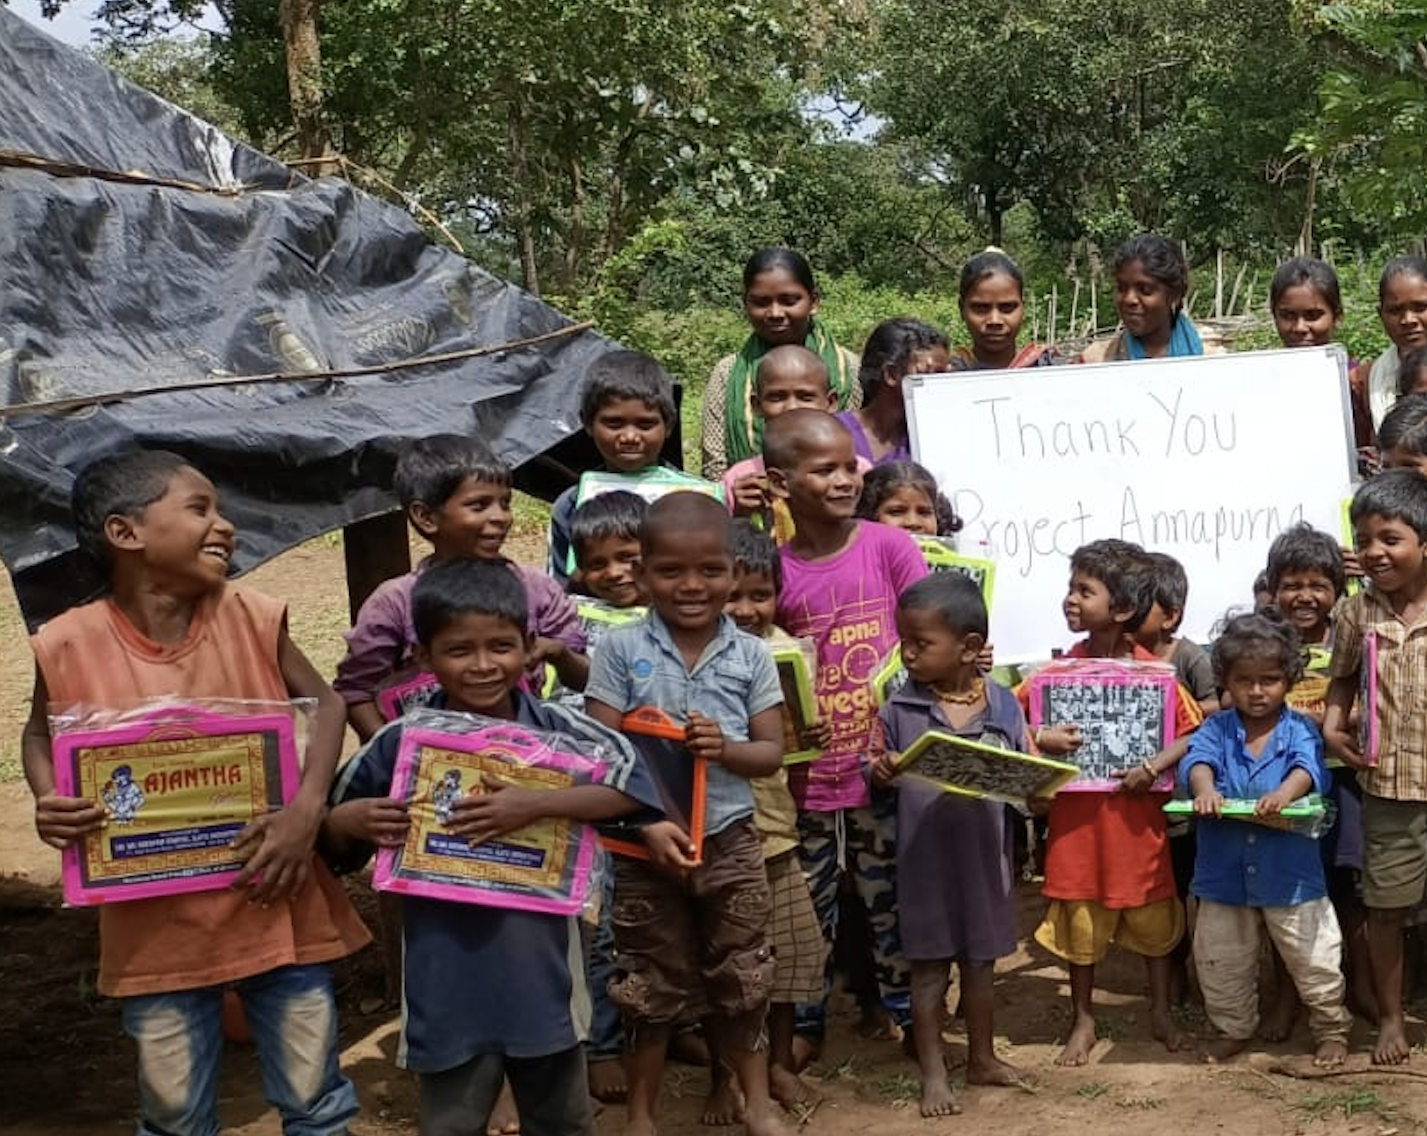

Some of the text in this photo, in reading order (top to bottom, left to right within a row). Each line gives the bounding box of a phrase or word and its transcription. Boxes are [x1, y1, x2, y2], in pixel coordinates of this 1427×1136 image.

[972, 396, 1140, 459] Thank
[953, 488, 1093, 578] Project
[829, 620, 881, 647] apna
[143, 764, 242, 795] AJANTHA
